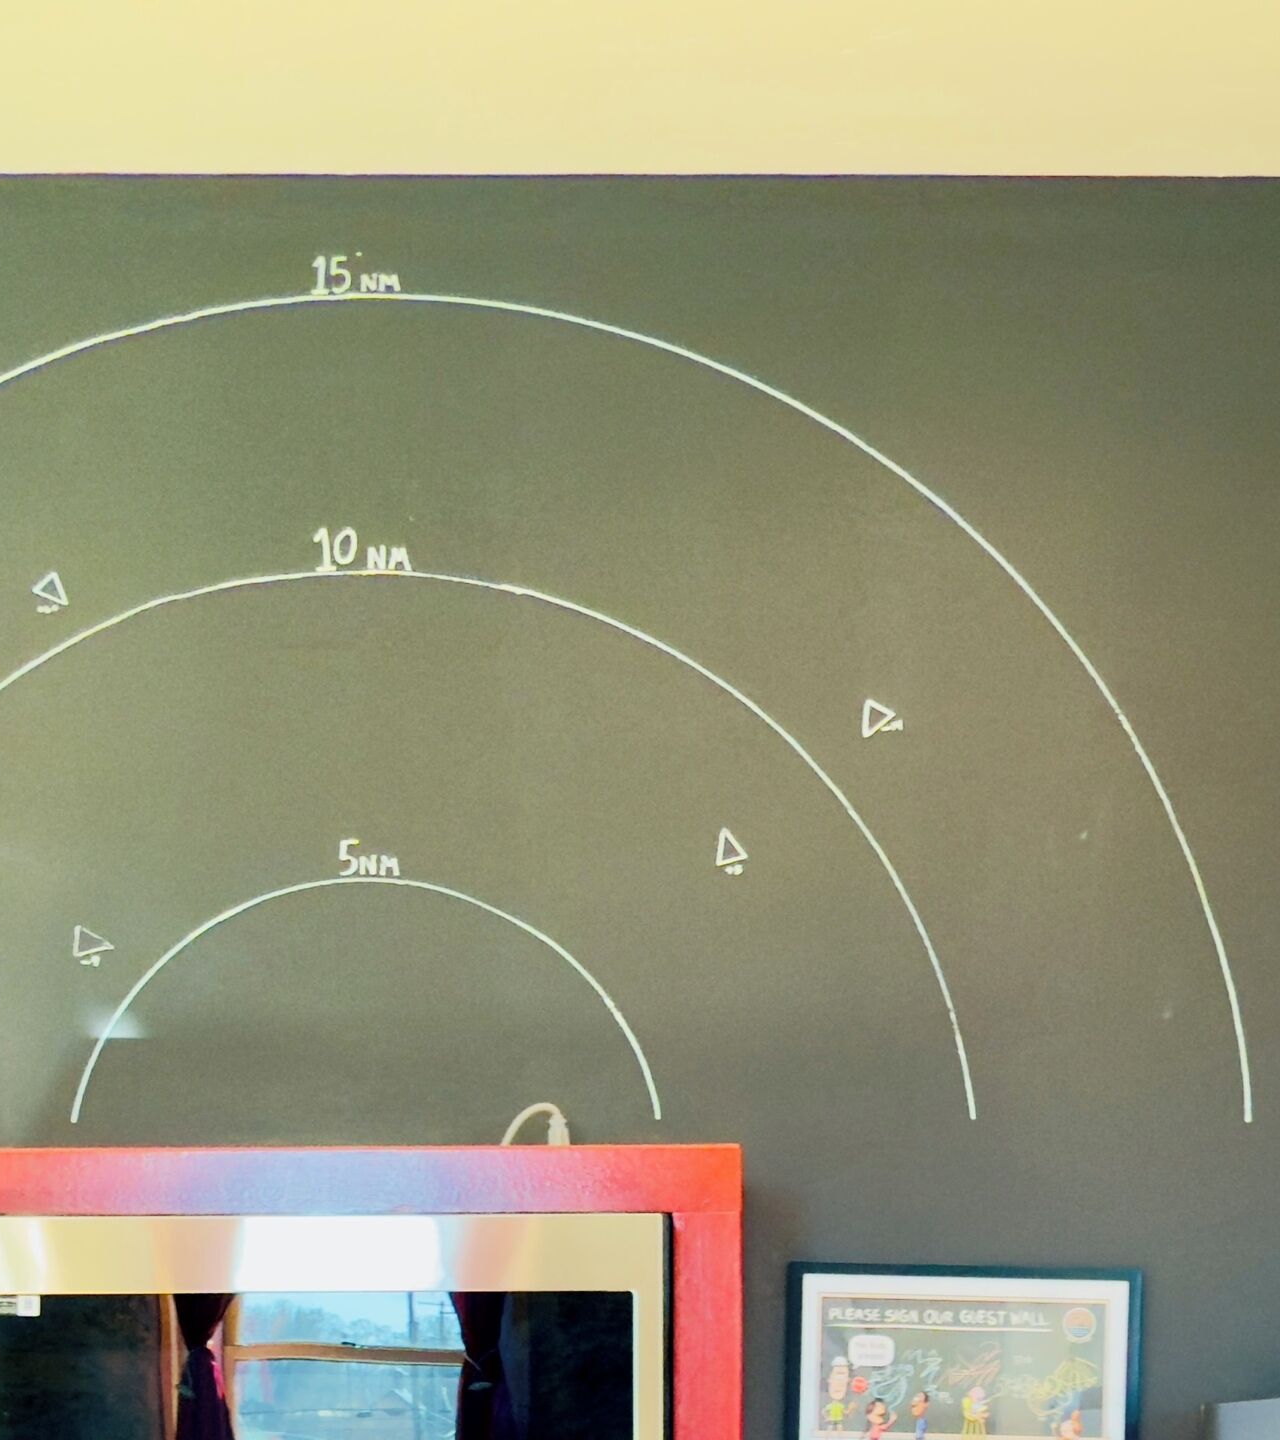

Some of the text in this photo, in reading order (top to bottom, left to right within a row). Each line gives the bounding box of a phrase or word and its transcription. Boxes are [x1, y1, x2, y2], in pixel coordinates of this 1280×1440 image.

[310, 255, 401, 295] 15 NM
[312, 526, 413, 572] 10 NM
[827, 1307, 1049, 1327] PLEASE SIGN OUR GUEST WALL
